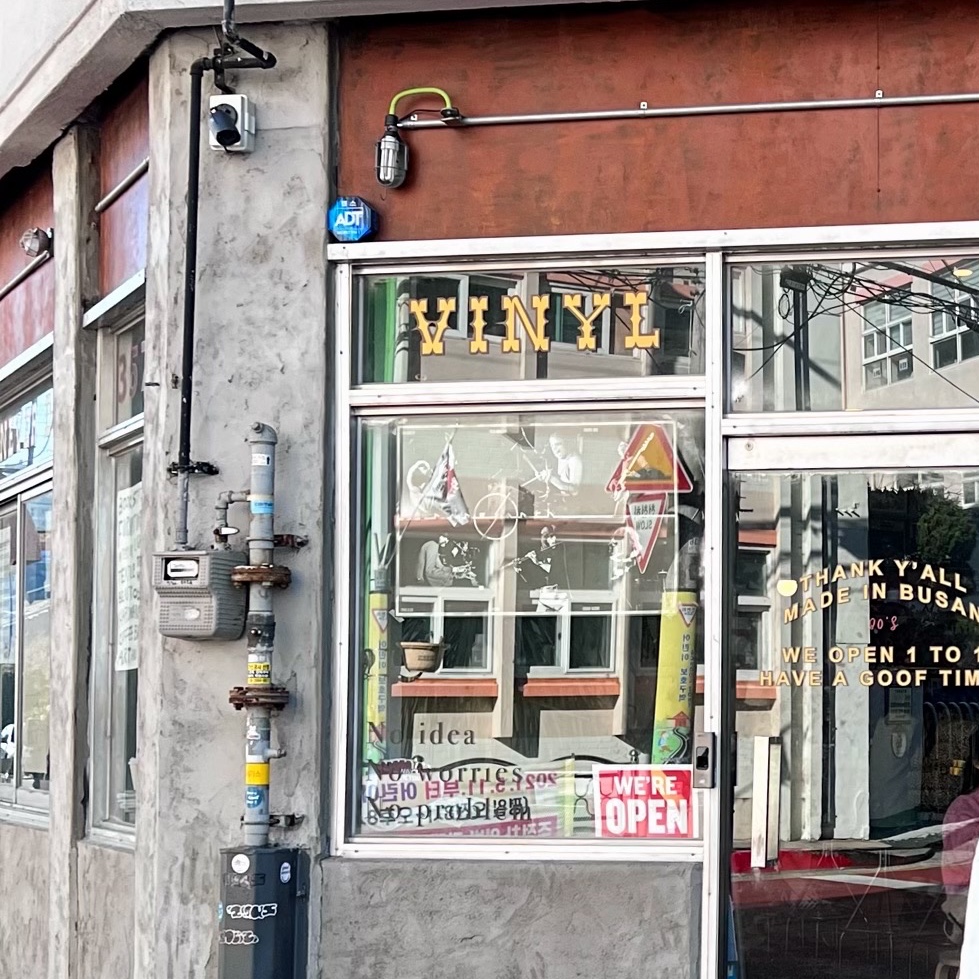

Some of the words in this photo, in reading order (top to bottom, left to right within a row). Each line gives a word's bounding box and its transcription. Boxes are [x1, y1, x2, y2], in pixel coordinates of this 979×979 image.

[334, 210, 363, 227] ADT
[409, 291, 660, 356] VINYL
[799, 559, 884, 593] THANK
[894, 560, 967, 593] Y'ALL
[784, 587, 850, 624] MADE
[863, 582, 887, 600] IN
[782, 647, 817, 663] WE
[829, 646, 894, 663] OPEN
[907, 646, 916, 663] 1
[930, 646, 961, 663] TO
[759, 670, 823, 687] HAVE
[832, 670, 848, 687] A
[859, 669, 927, 687] GOOF
[367, 721, 403, 745] No
[419, 721, 476, 745] idea
[613, 775, 677, 796] WE'RE
[605, 797, 688, 835] OPEN
